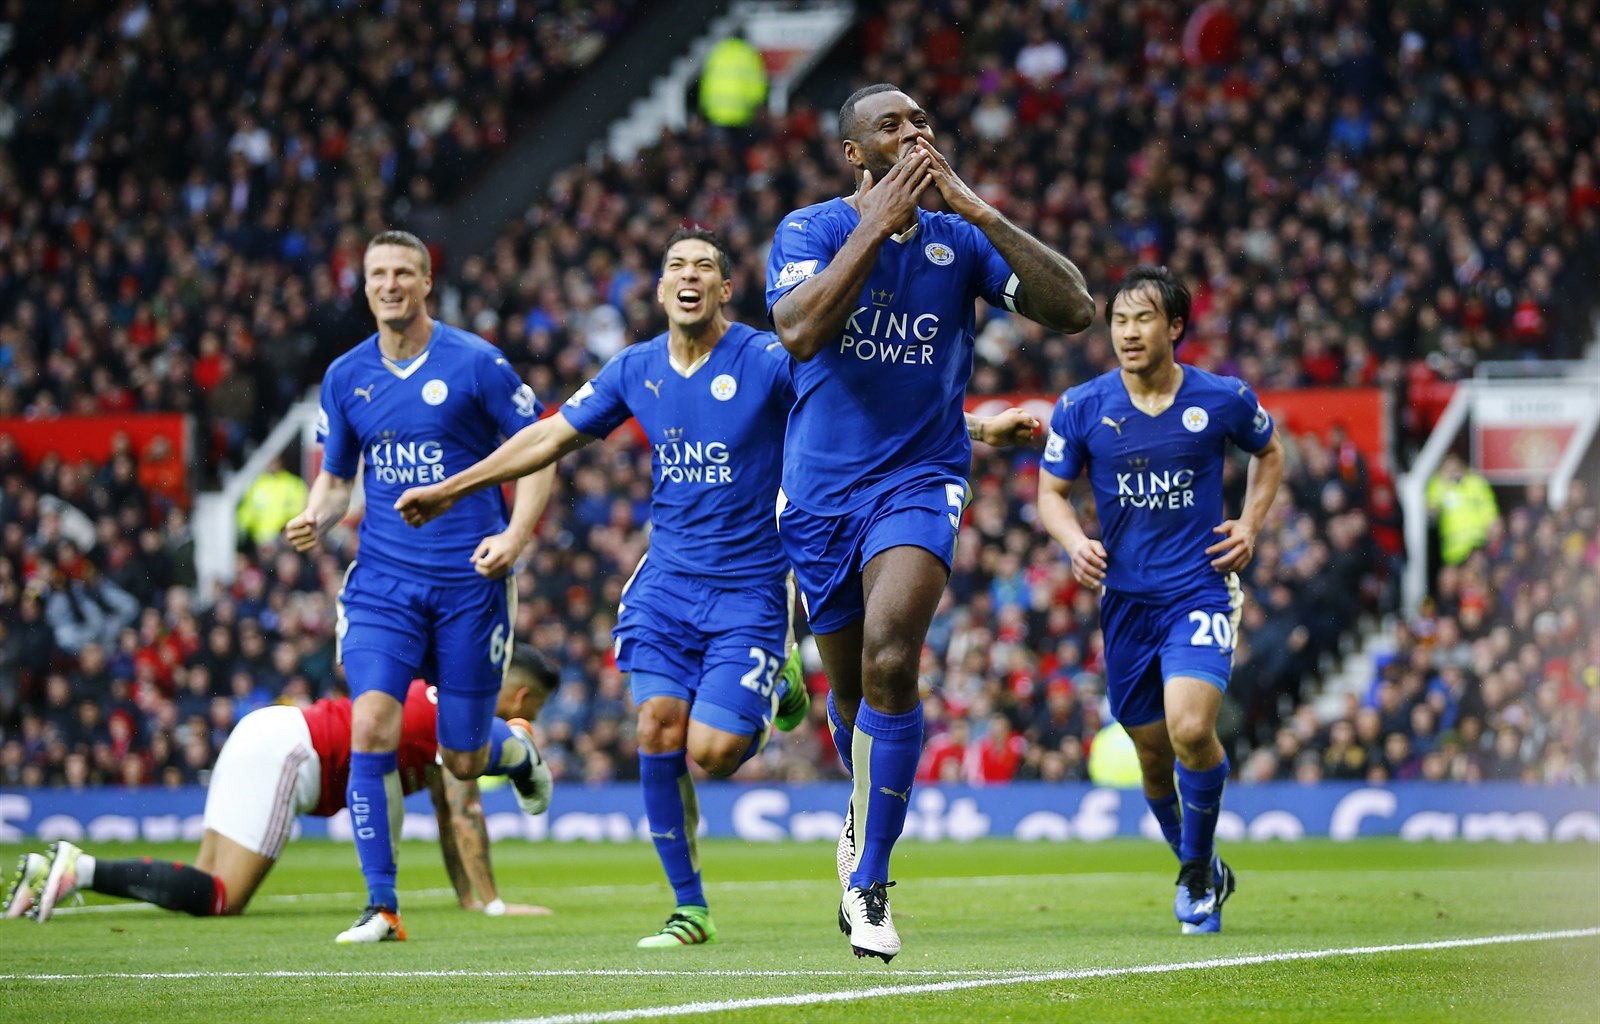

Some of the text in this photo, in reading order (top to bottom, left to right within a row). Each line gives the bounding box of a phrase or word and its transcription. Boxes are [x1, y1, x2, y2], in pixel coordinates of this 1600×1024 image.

[845, 306, 940, 341] KING
[840, 334, 934, 365] POWER
[371, 441, 444, 467] KING
[654, 441, 729, 465] KING
[375, 463, 446, 485] POWER
[660, 465, 733, 484] POWER
[1116, 469, 1195, 496] KING
[945, 483, 965, 530] 5
[489, 622, 504, 664] 6
[1188, 609, 1232, 650] 20
[740, 646, 779, 697] 23
